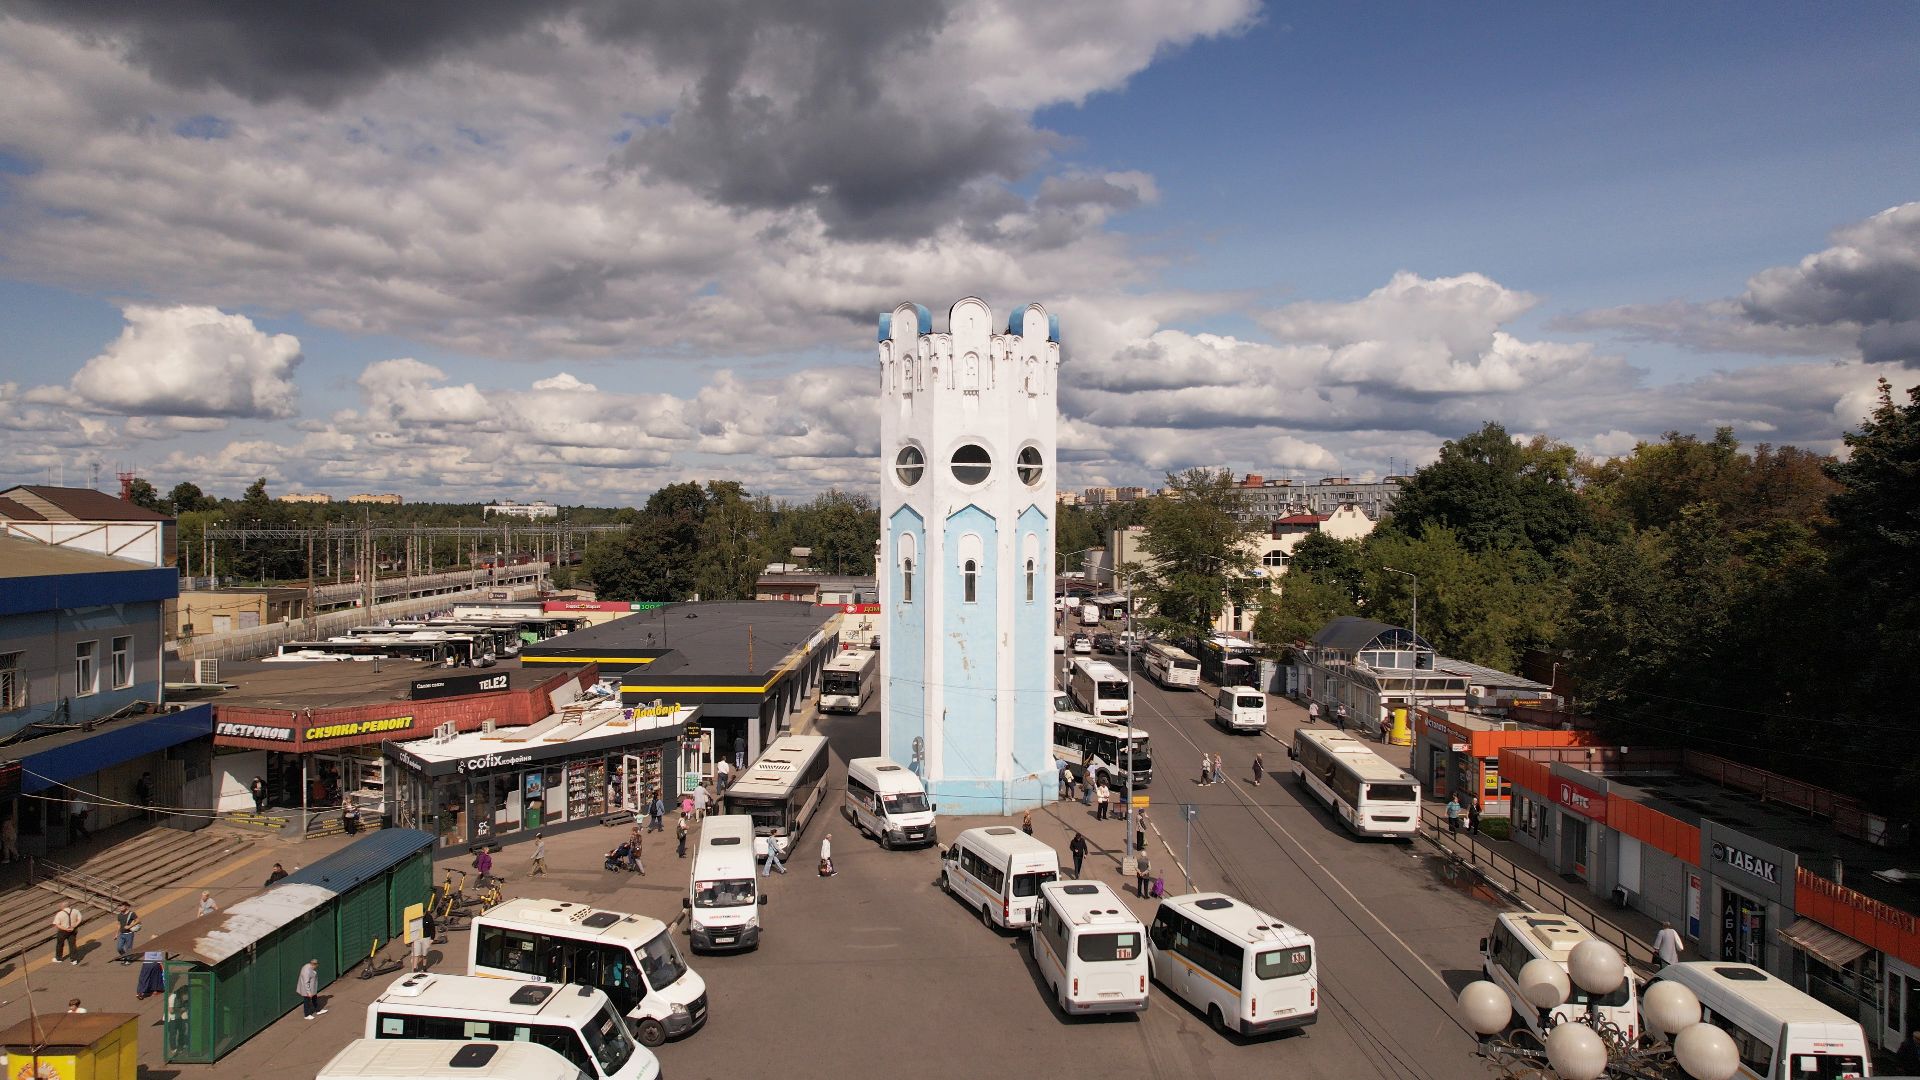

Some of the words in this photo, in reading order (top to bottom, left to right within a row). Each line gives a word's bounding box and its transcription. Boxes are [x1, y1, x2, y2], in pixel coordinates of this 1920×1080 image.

[479, 675, 507, 690] TELE2
[216, 722, 291, 741] ГАСТРОНОМ
[305, 716, 413, 740] СКУПКА-РЕМОНТ
[467, 753, 502, 770] cofix
[1726, 846, 1775, 881] ТАБАК
